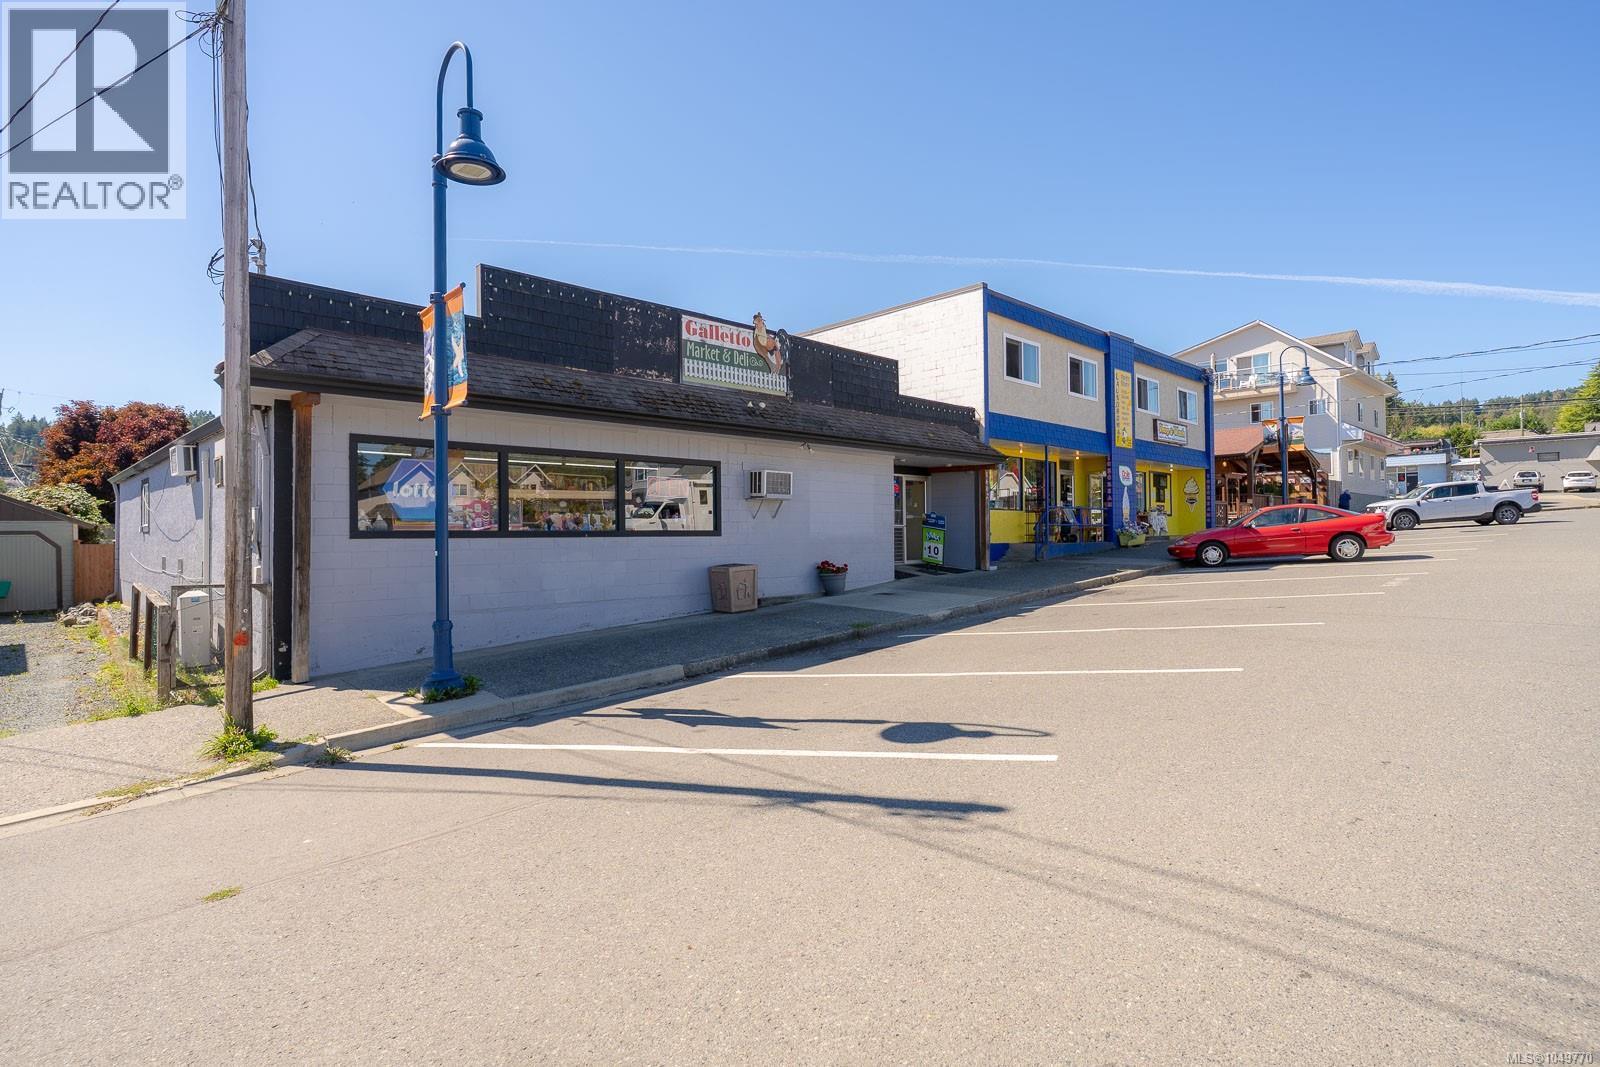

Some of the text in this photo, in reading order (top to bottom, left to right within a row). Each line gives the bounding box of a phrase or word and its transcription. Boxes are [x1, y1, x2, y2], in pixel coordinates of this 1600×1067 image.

[685, 320, 751, 347] Galletto
[686, 341, 749, 367] Market & Deli
